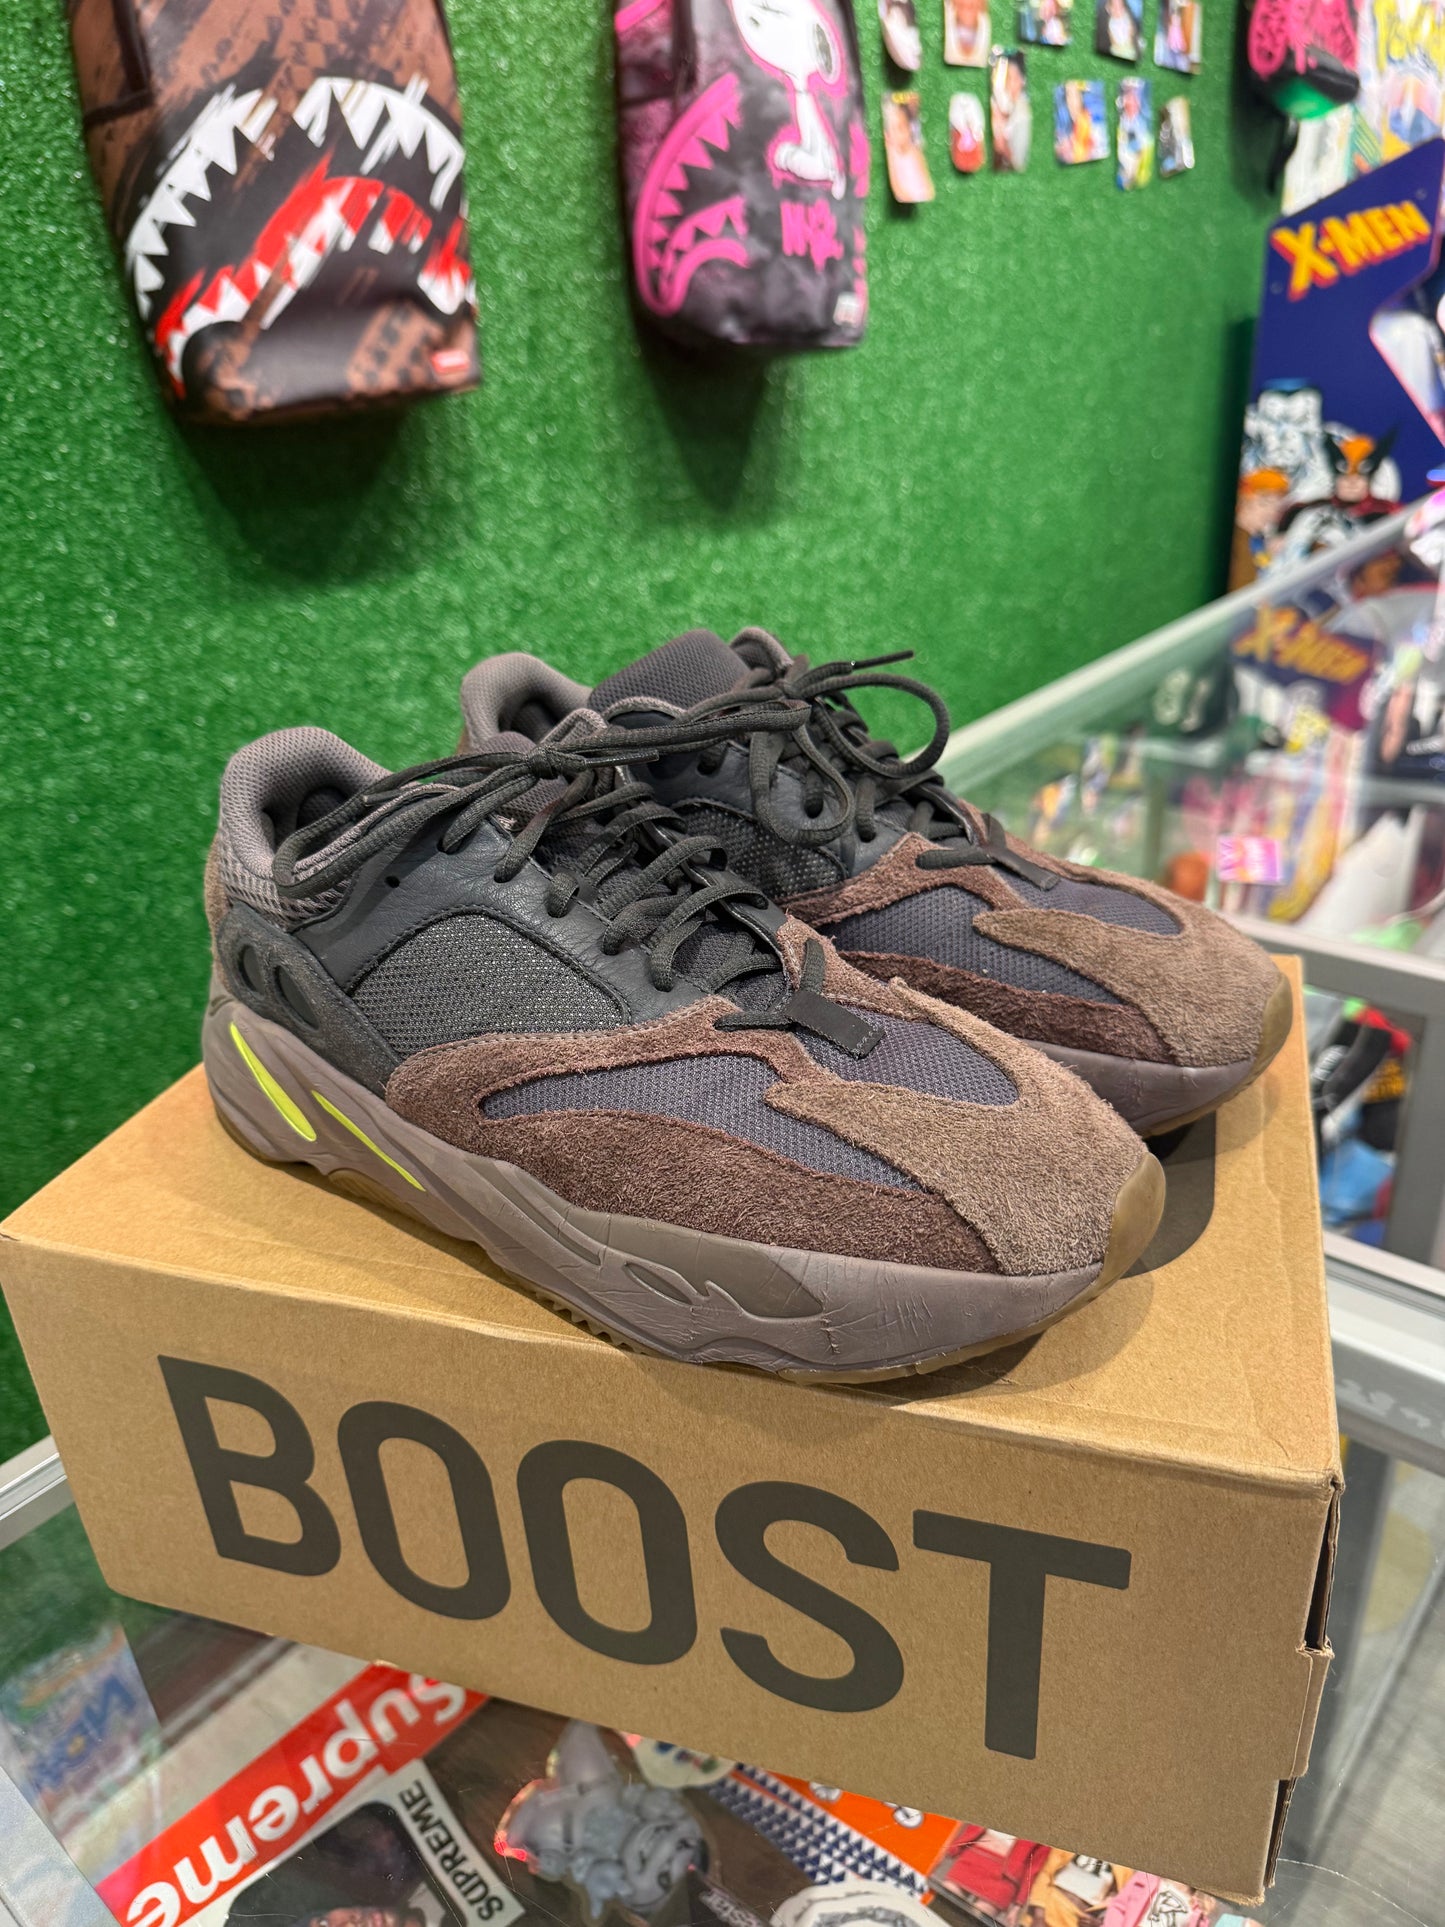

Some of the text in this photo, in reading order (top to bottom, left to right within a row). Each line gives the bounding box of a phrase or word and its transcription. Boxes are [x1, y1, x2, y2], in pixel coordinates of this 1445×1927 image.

[1270, 200, 1431, 302] X-MEN
[157, 1355, 1131, 1759] BOOST
[127, 1671, 467, 1927] Supreme
[399, 1780, 504, 1921] SUPREME
